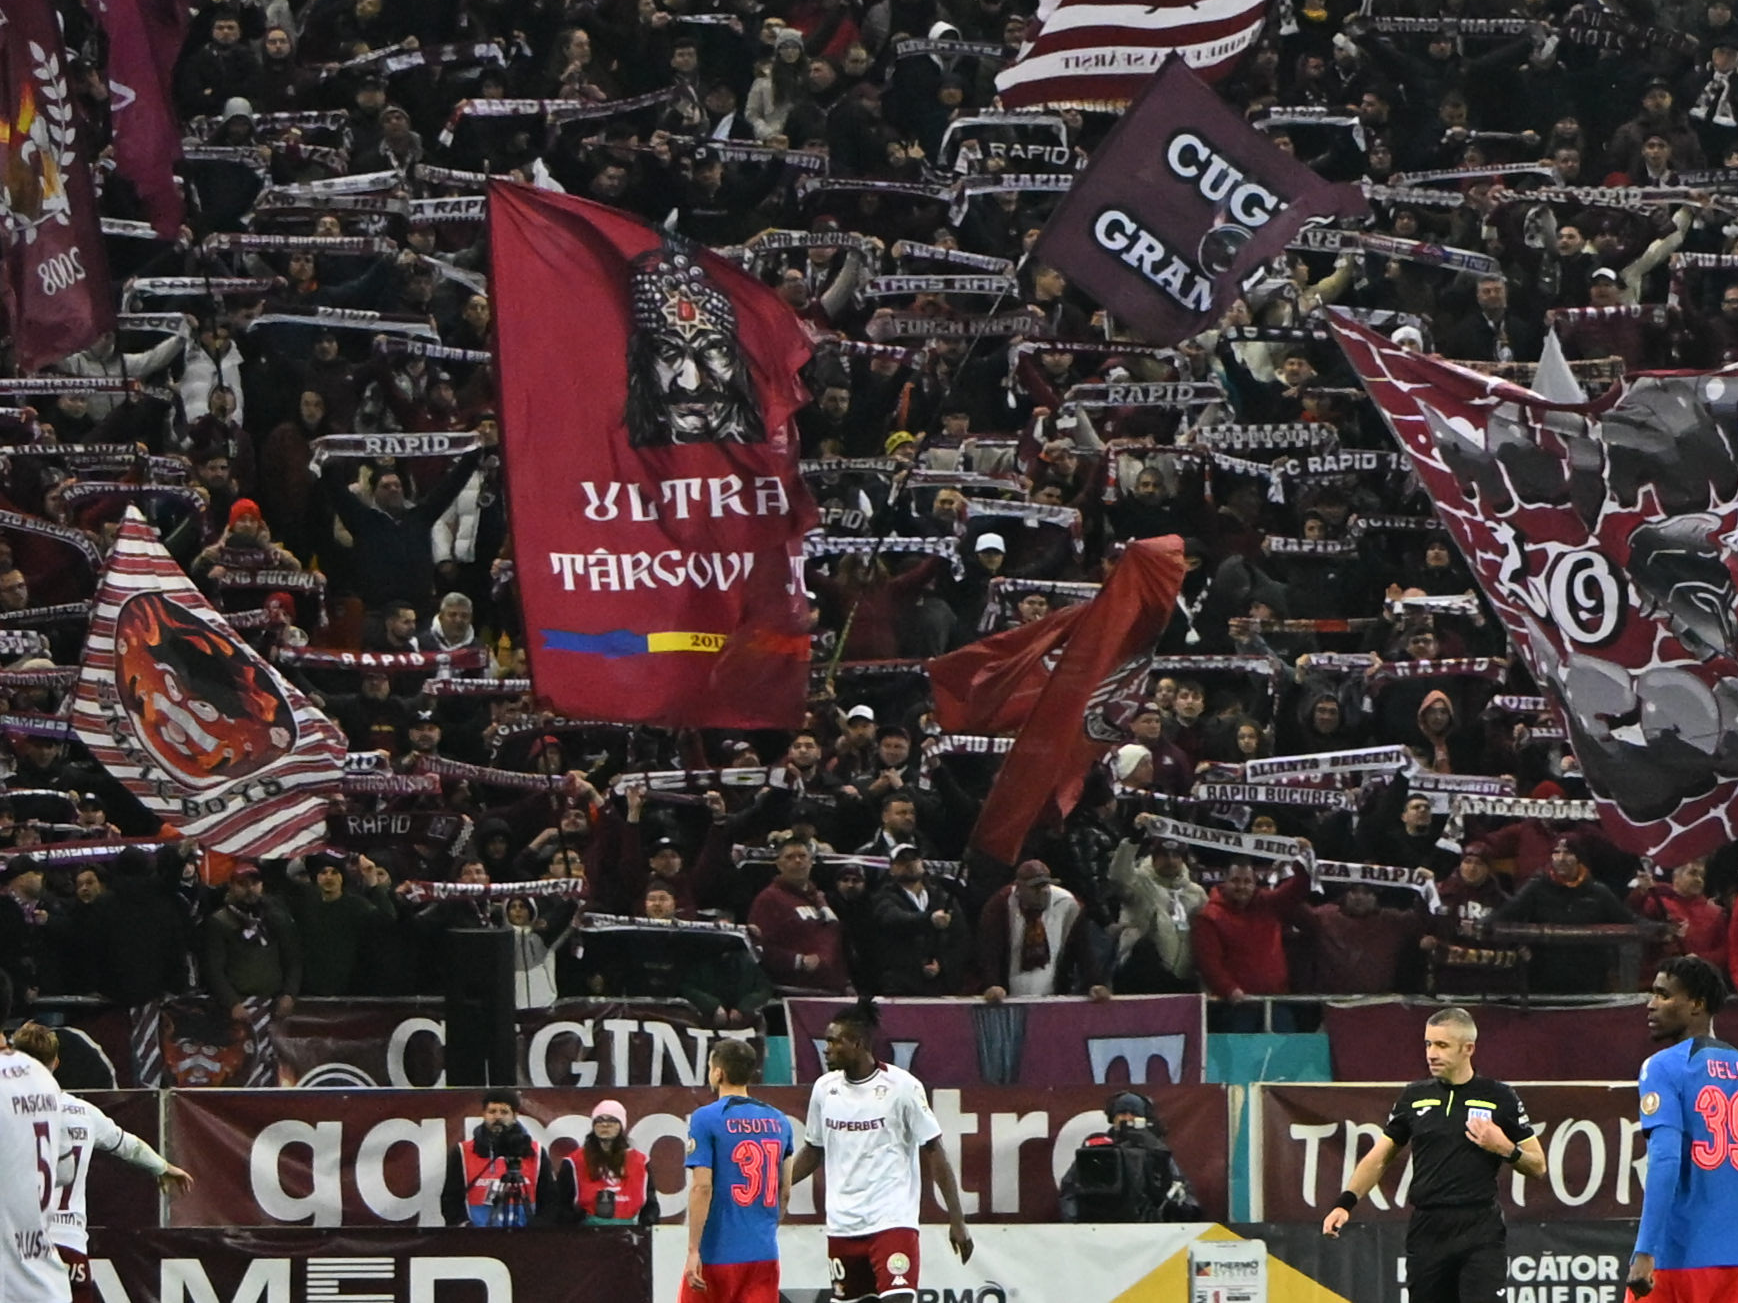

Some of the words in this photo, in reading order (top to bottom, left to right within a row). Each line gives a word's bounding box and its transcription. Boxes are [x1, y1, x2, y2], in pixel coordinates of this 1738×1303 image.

[990, 142, 1070, 163] RAPID
[1105, 382, 1194, 404] RAPID
[365, 434, 450, 455] RAPID
[1307, 453, 1377, 472] RAPID
[580, 476, 790, 523] ULTRA
[341, 651, 425, 668] RAPID
[1205, 784, 1264, 802] RAPID
[347, 812, 412, 836] RAPID
[1359, 865, 1427, 887] RAPID
[825, 1116, 887, 1133] SUPERBET
[32, 1121, 53, 1213] 5
[729, 1138, 782, 1208] 31
